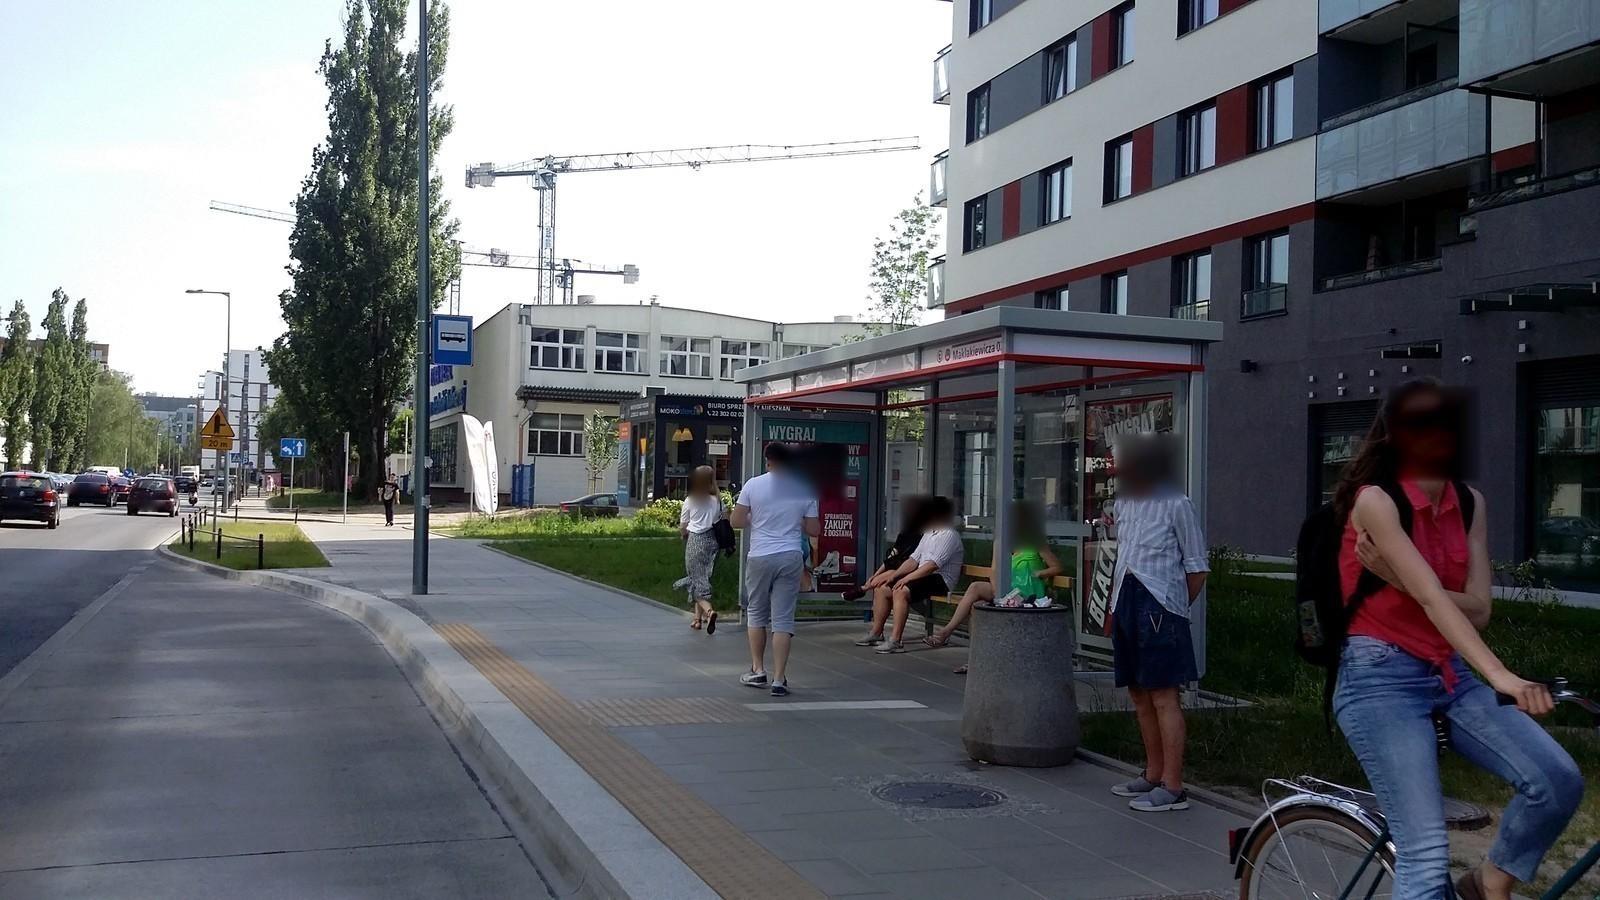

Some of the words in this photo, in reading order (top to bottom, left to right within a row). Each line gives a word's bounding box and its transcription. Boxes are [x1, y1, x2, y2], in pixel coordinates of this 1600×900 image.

[952, 344, 995, 360] Maklakiewicza
[768, 425, 816, 441] WYGRAJ
[208, 439, 219, 448] 20
[220, 440, 228, 448] m
[824, 519, 853, 530] ZAKUPY
[1089, 540, 1117, 628] BLACK
